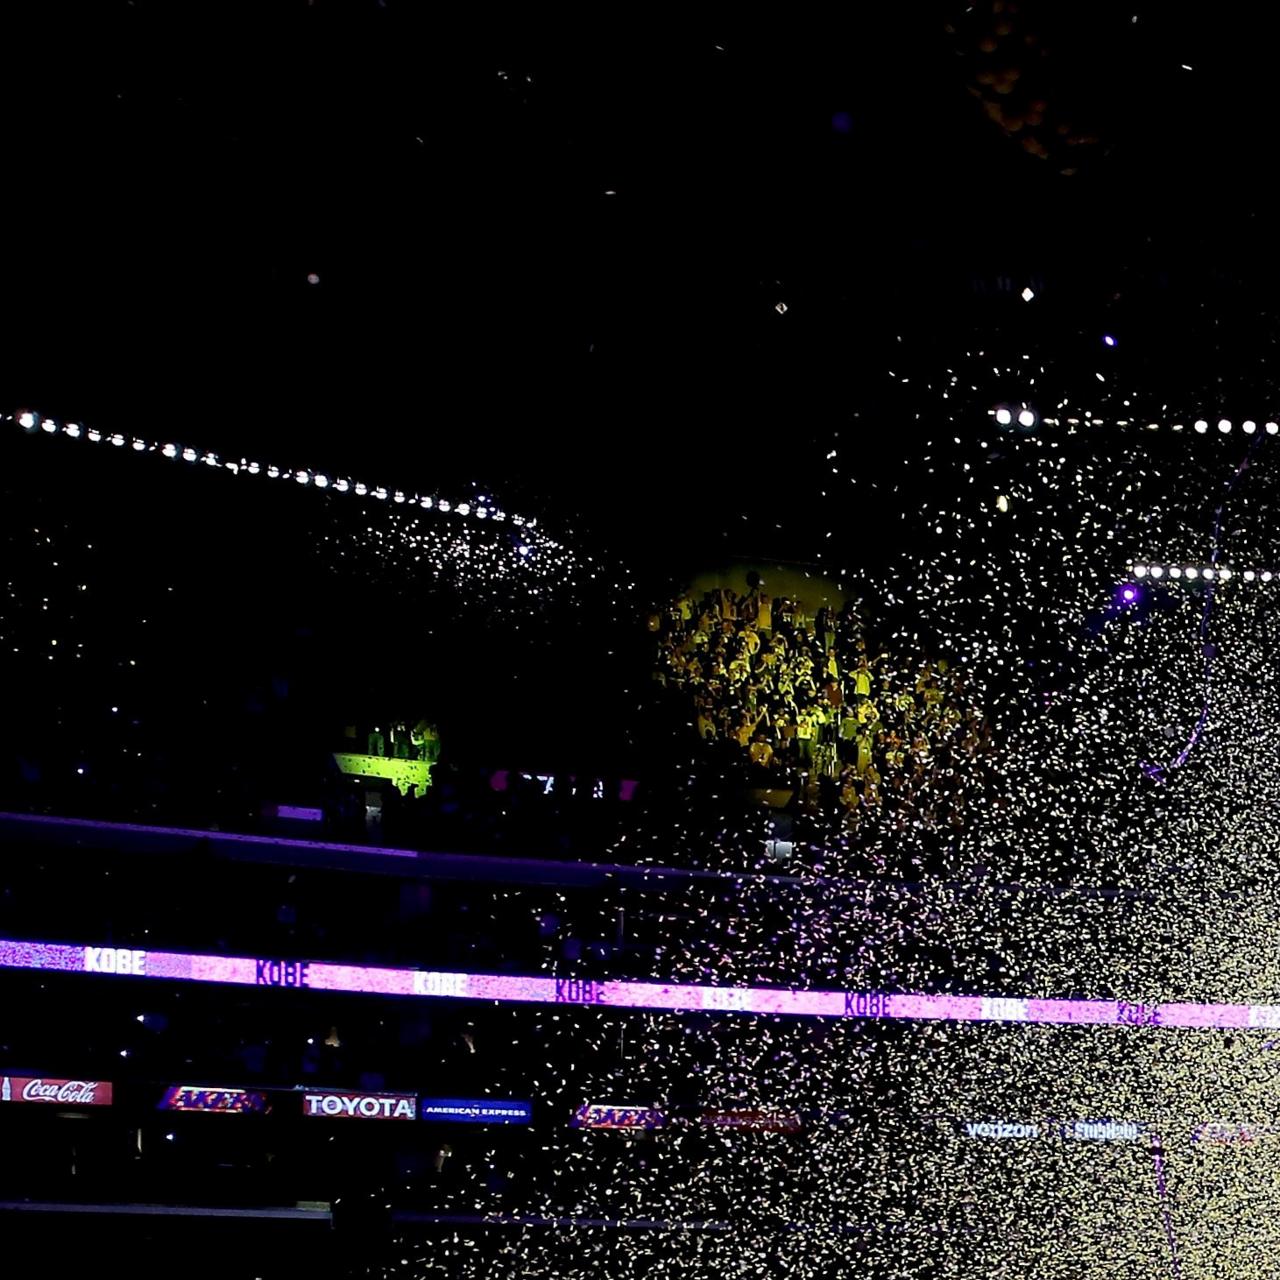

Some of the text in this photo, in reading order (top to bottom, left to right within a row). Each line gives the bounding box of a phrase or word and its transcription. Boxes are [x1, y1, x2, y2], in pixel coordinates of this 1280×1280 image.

[86, 946, 147, 976] KOBE
[256, 959, 310, 986] KOBE
[413, 971, 468, 997] KOBE
[555, 979, 605, 1004] KOBE
[844, 991, 892, 1017] KOBE
[305, 1094, 414, 1118] TOYOTA
[426, 1106, 527, 1117] AMERICAN EXPRESS
[966, 1121, 1039, 1139] verizon
